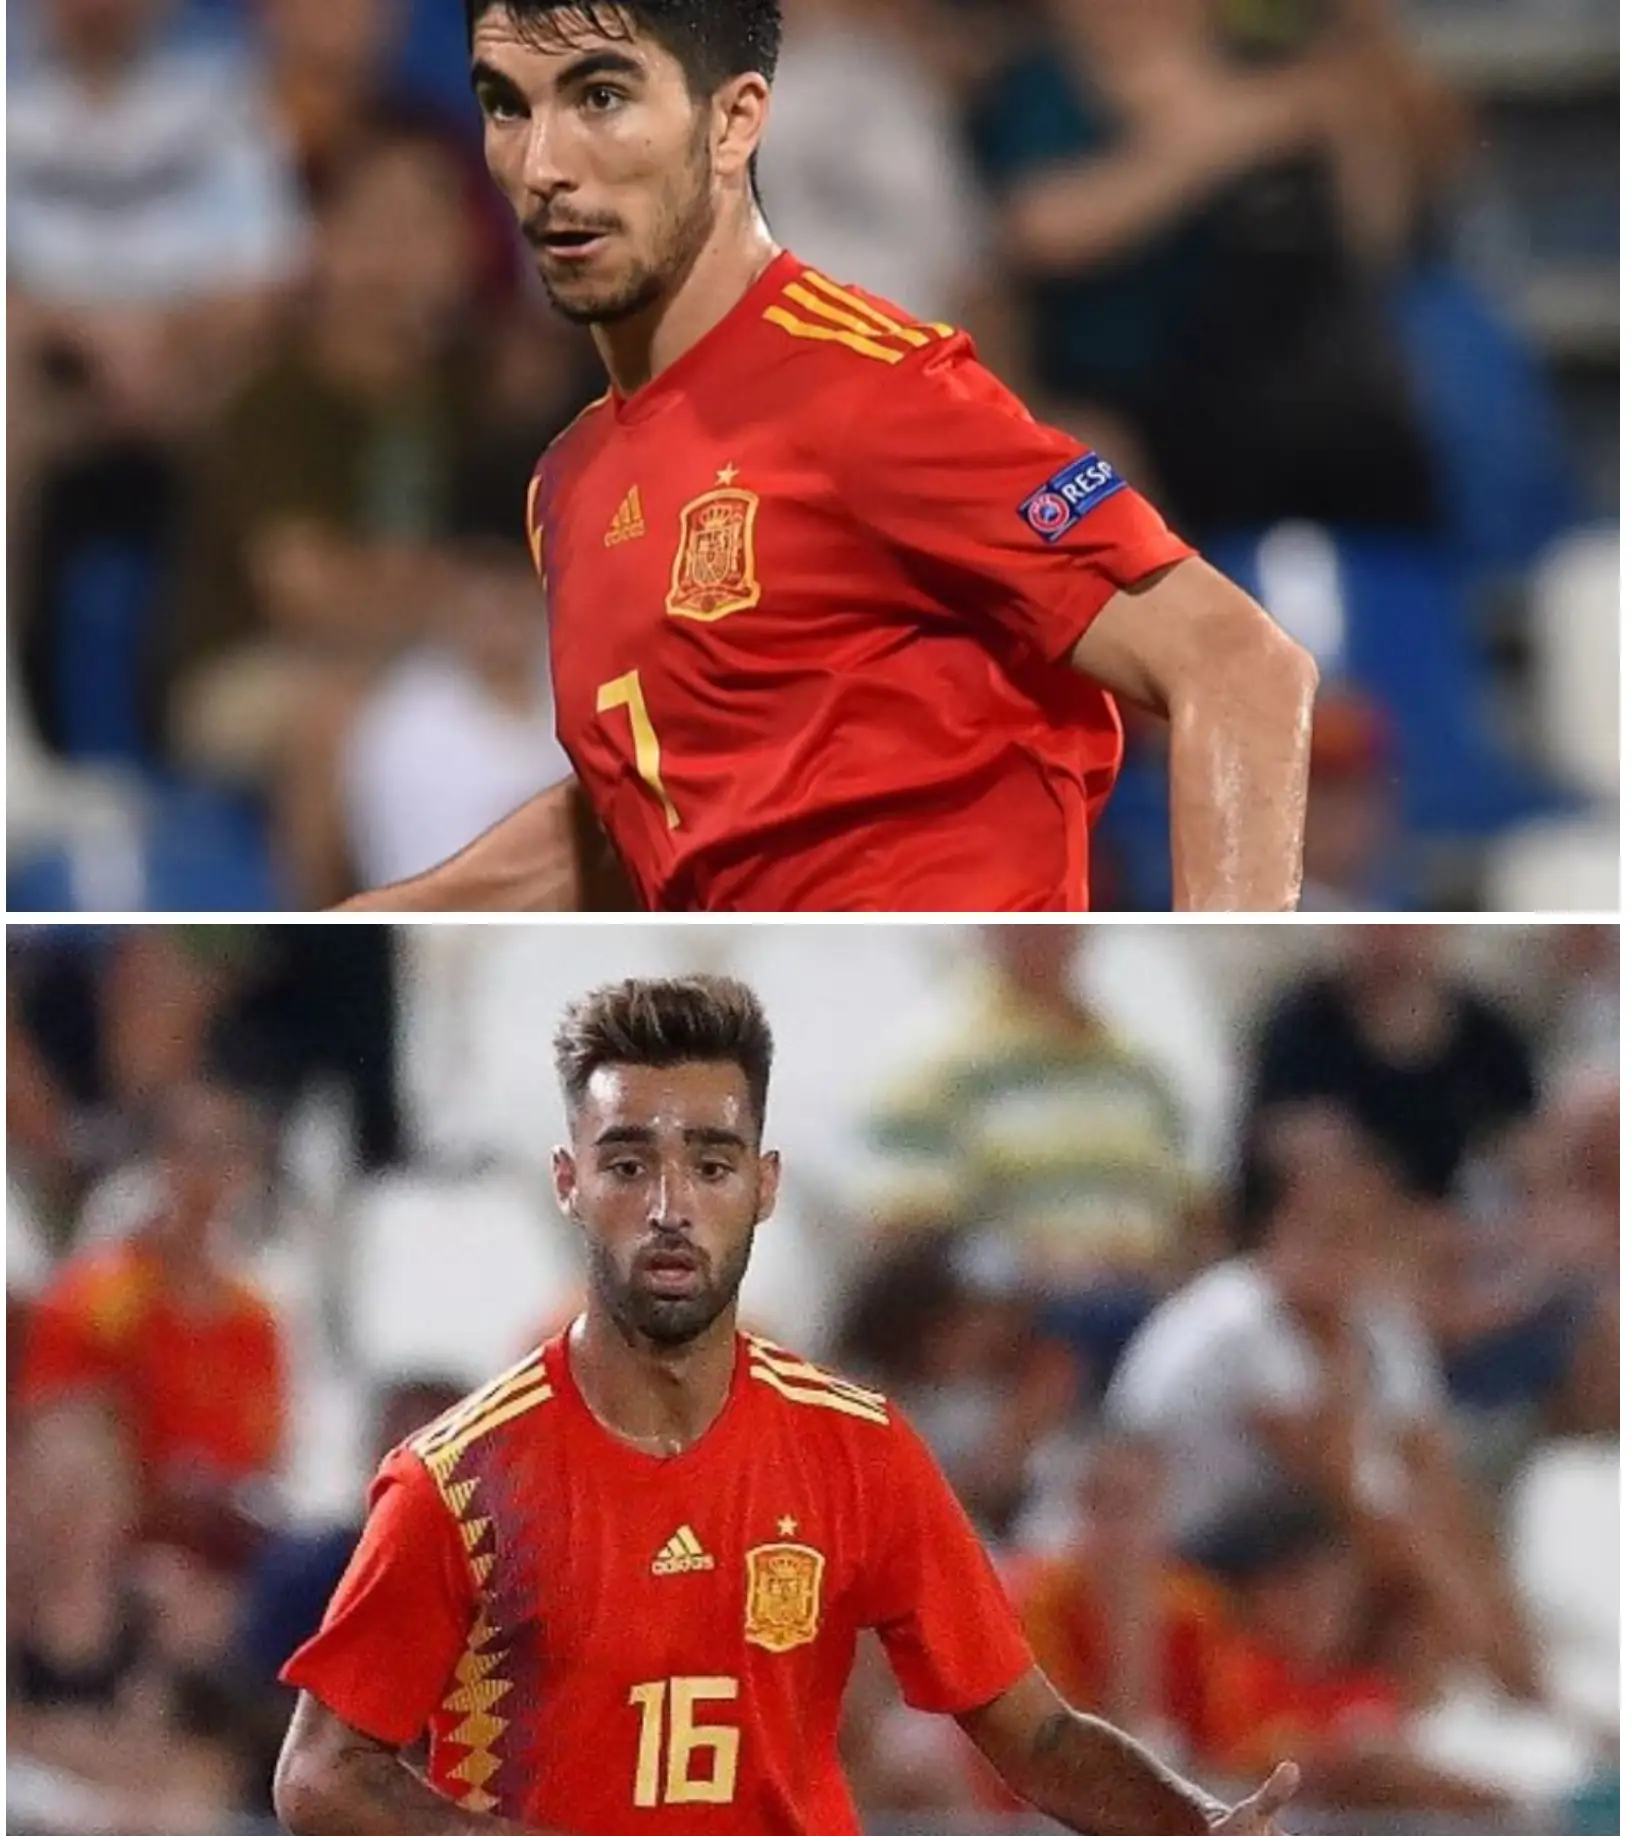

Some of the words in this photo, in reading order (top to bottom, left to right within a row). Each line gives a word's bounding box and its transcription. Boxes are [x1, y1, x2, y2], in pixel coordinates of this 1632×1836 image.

[596, 668, 681, 830] 7
[651, 1553, 715, 1576] adidas
[627, 1675, 740, 1807] 16
